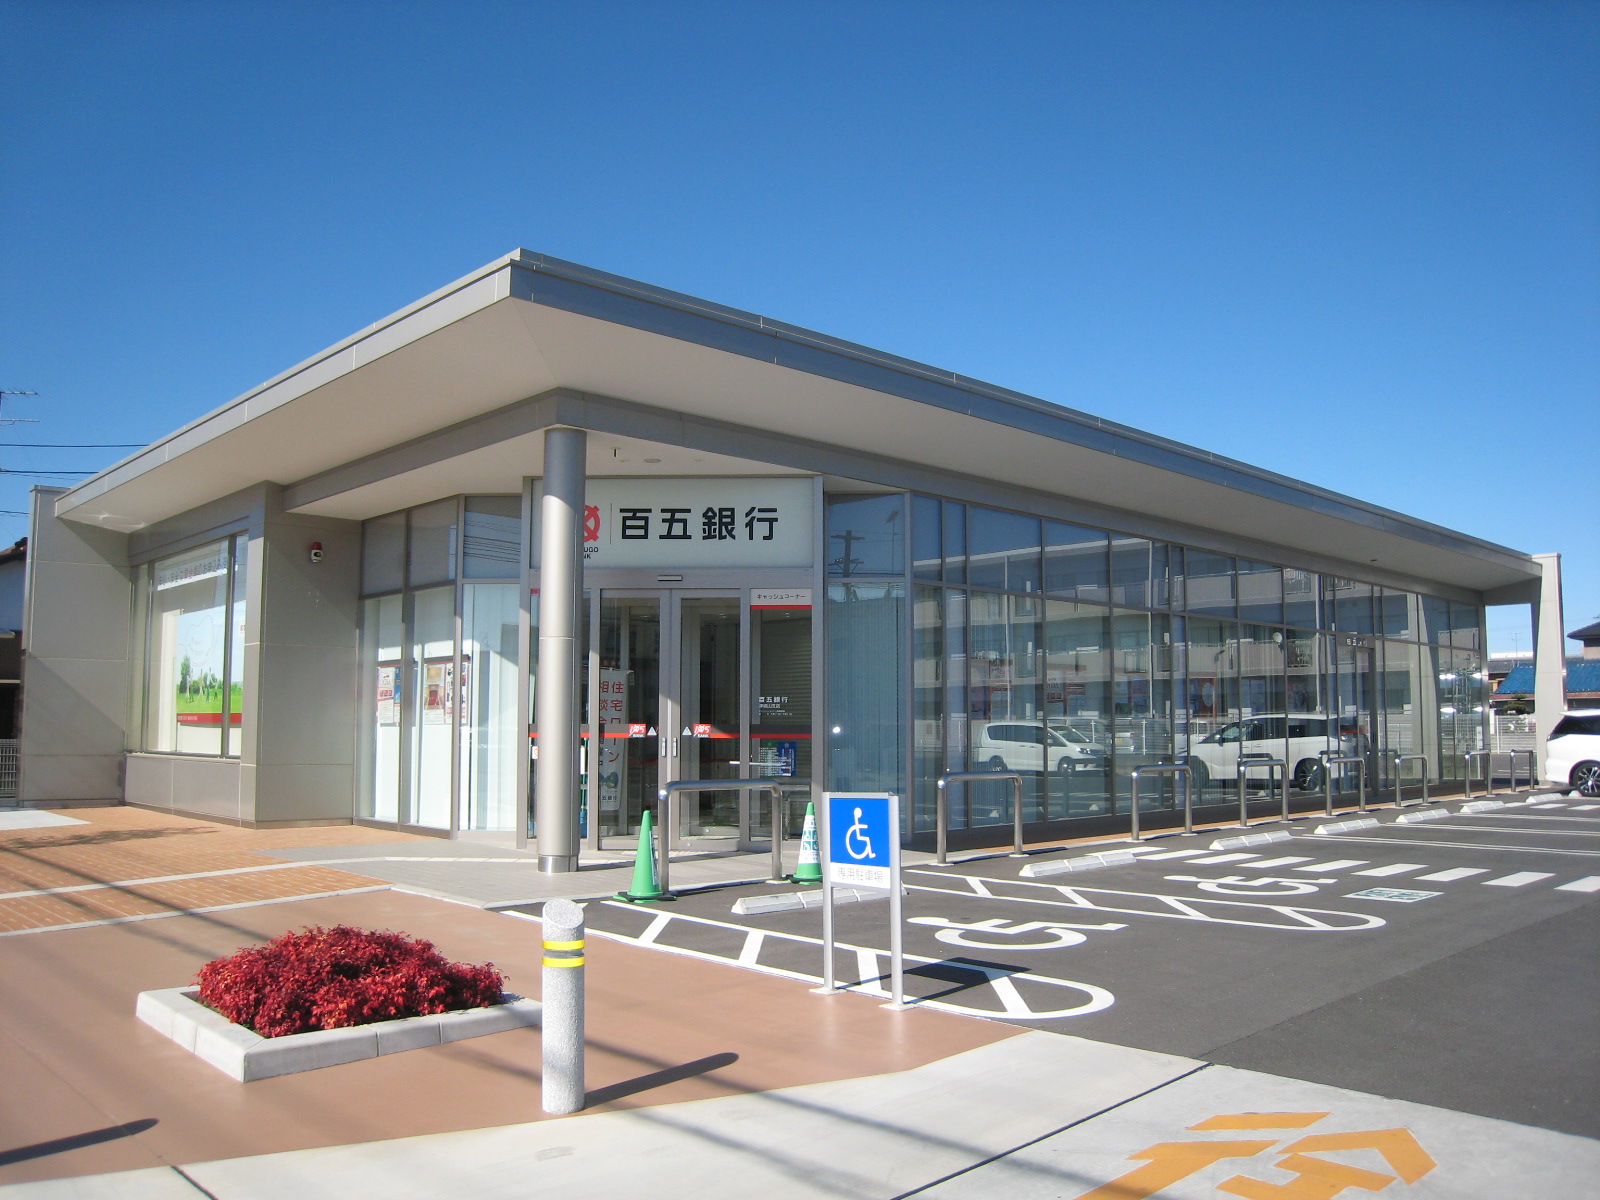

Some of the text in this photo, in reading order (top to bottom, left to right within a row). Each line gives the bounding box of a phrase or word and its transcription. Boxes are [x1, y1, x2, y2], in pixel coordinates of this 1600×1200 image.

[619, 506, 778, 540] 百五銀行
[758, 696, 789, 704] 百五銀行
